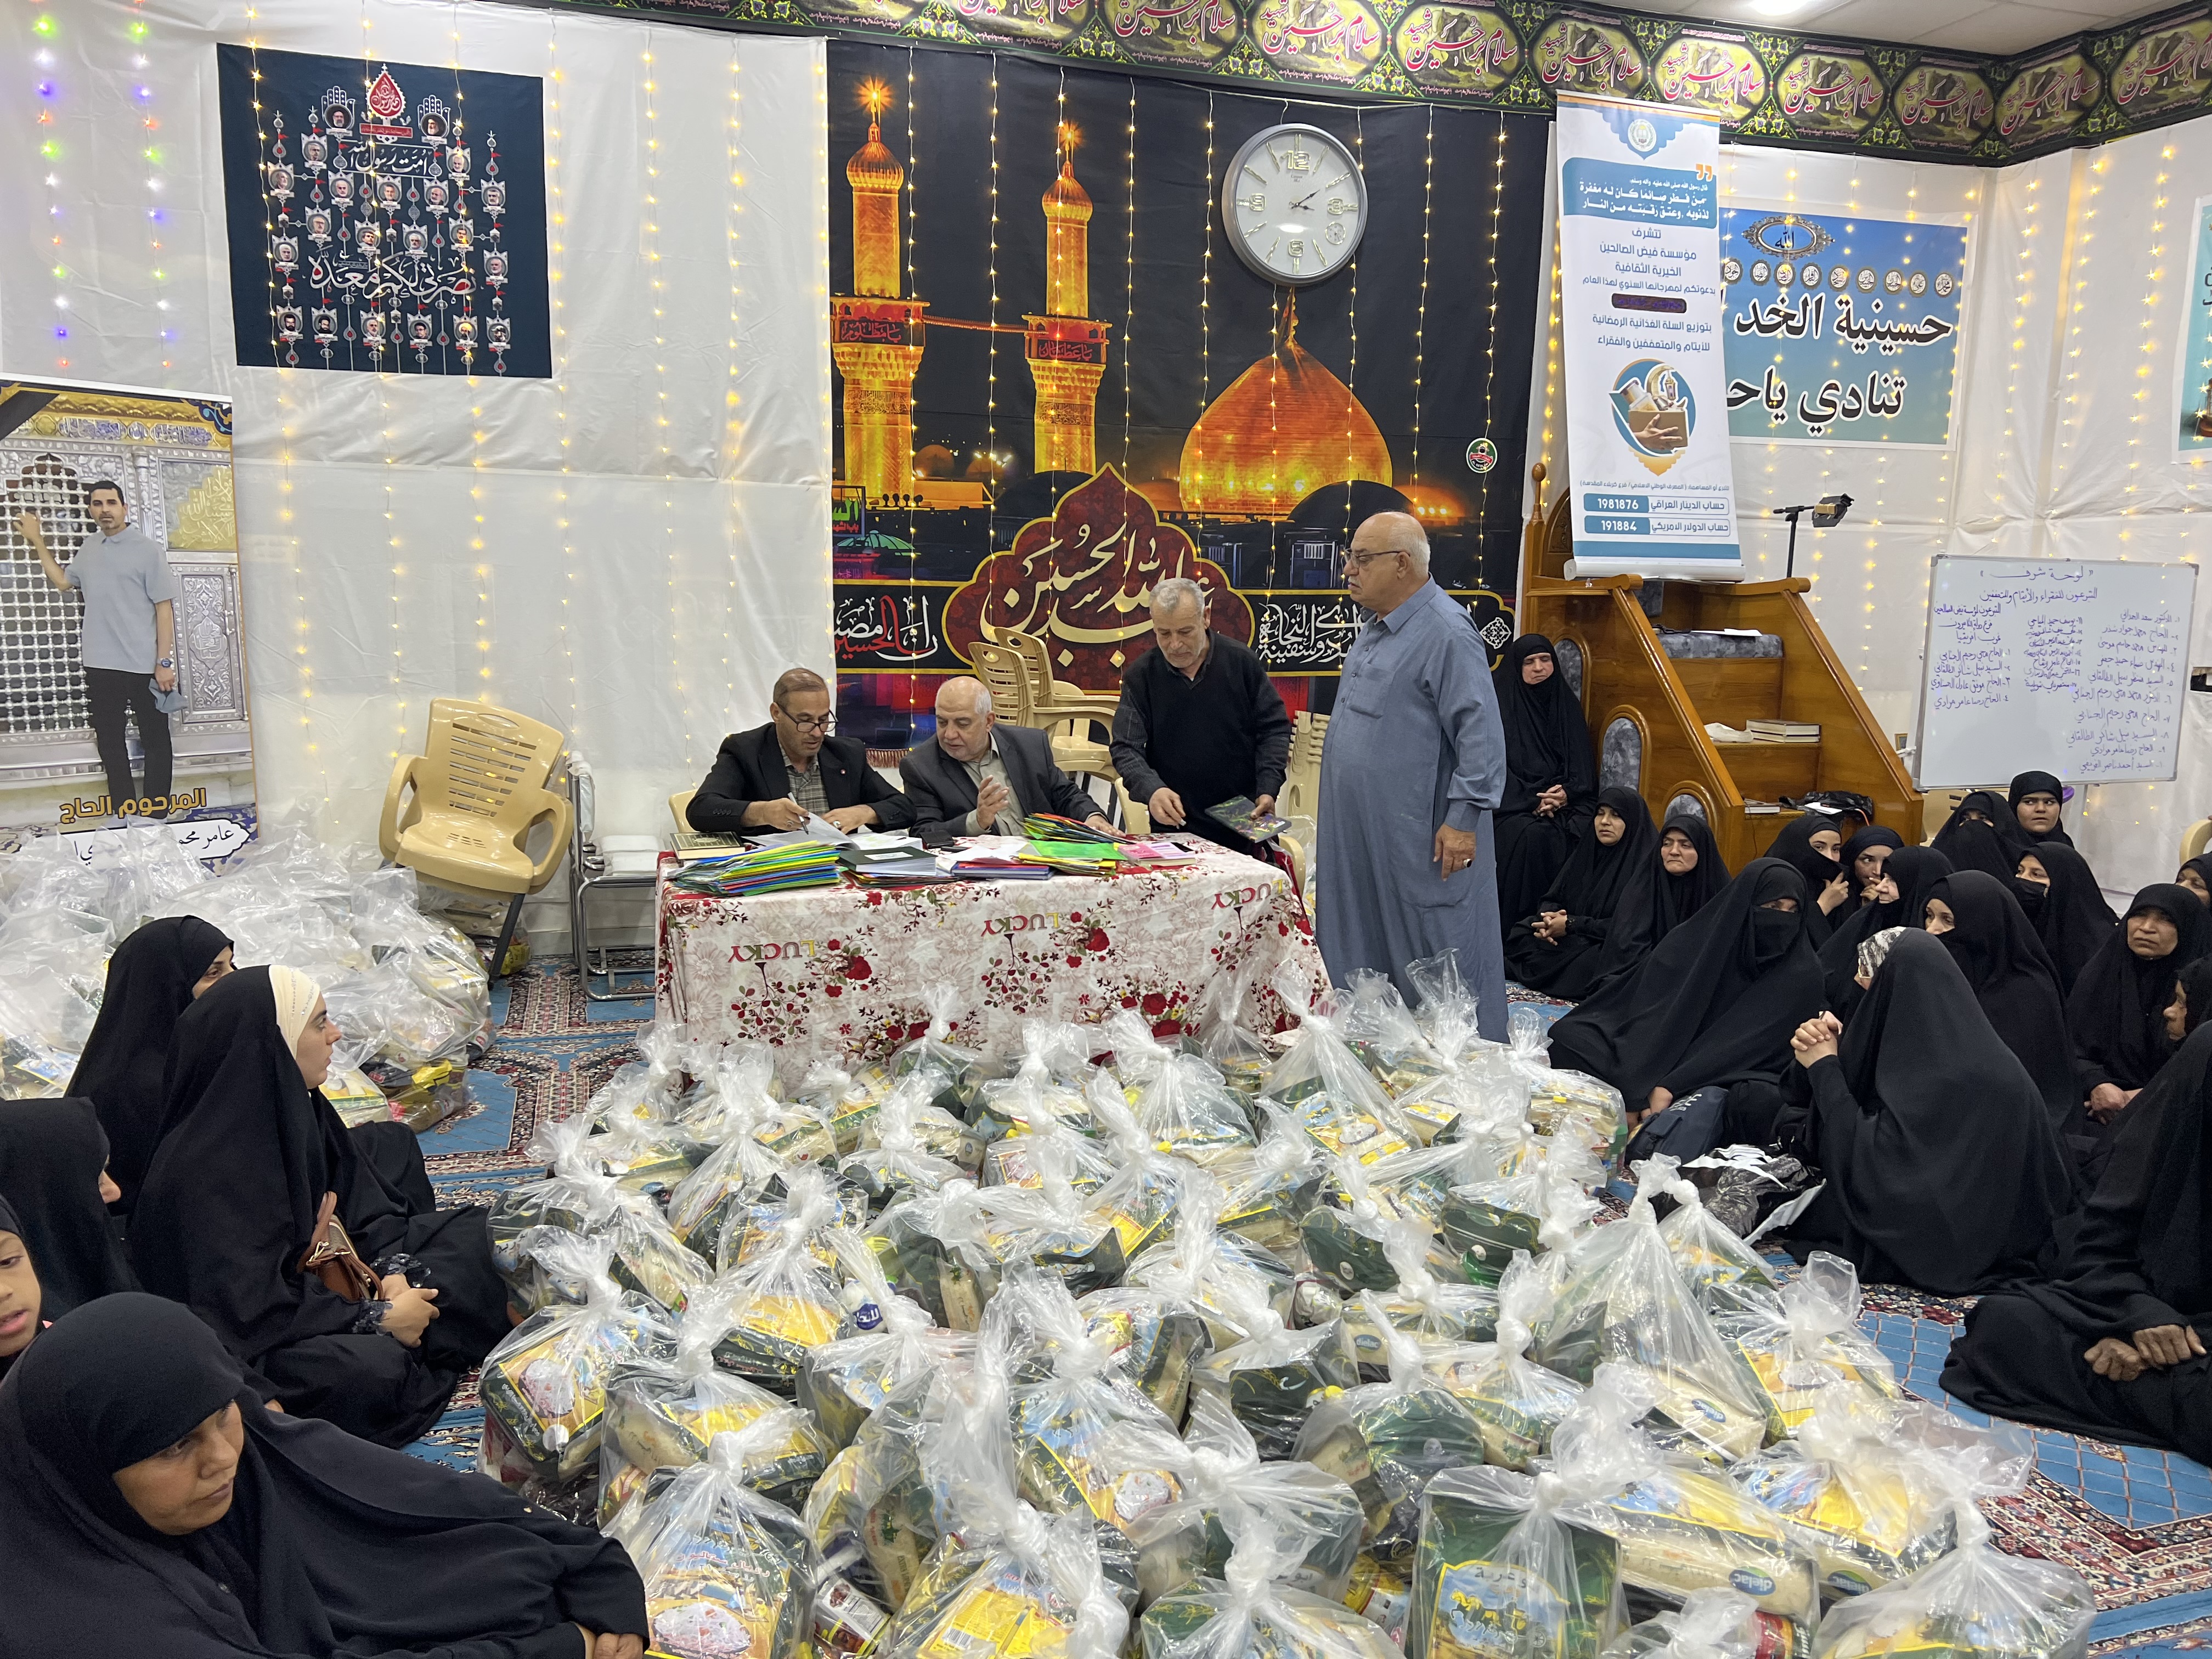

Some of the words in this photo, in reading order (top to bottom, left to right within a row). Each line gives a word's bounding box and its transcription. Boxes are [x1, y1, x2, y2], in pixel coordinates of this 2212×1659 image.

[1345, 14, 1381, 59] سلام
[1485, 28, 1517, 72] سلام
[1611, 46, 1641, 88] سلام
[1734, 61, 1764, 104] سلام
[2064, 66, 2099, 111] سلام
[1853, 75, 1883, 116] سلام
[1967, 88, 1994, 128] سلام
[1281, 150, 1311, 170] 12
[1249, 194, 1266, 211] 9
[1328, 197, 1344, 215] 3
[1583, 198, 1609, 209] النار
[1632, 227, 1661, 239] تتشرف
[1775, 225, 1794, 249] الله
[1289, 239, 1304, 257] 6
[1600, 241, 1634, 254] الصالحين
[1637, 246, 1658, 258] فيض
[1660, 248, 1696, 261] مؤسسة
[1615, 262, 1650, 274] الثقافية
[1652, 265, 1681, 278] الخيرية
[1583, 275, 1601, 285] العام
[1602, 278, 1617, 286] لهذا
[1619, 280, 1644, 290] السنوي
[1645, 281, 1682, 292] لمهرجانها
[1684, 284, 1716, 297] بدعوتكم
[1593, 314, 1628, 328] الرمضانية
[1629, 318, 1661, 329] الغذائية
[1662, 320, 1684, 330] السلة
[1836, 298, 1952, 354] حسينية
[1686, 323, 1712, 334] بتوزيع
[1598, 335, 1630, 348] والفقراء
[1633, 338, 1681, 352] والمتعففين
[1683, 342, 1710, 353] للأيتام
[1799, 371, 1906, 435] تنادي
[1598, 498, 1639, 510] 1981876
[1651, 500, 1678, 512] العراقي
[1680, 501, 1701, 511] الدينار
[1702, 503, 1724, 511] حساب
[1601, 521, 1637, 531] 191884
[1684, 523, 1706, 532] الدولار
[1707, 523, 1728, 532] حساب
[1989, 567, 2046, 580] شرف
[2049, 565, 2083, 582] لوحة
[2041, 589, 2064, 603] للفقراء
[1983, 619, 1993, 633] فرع
[2150, 626, 2168, 642] الحاج
[1989, 647, 2002, 662] الحاج
[1985, 661, 2002, 674] السيد
[1987, 675, 2001, 693] الحاج
[1934, 696, 1955, 709] مرادي
[1955, 696, 1971, 708] عامر
[1984, 693, 2001, 708] الحاج
[2142, 707, 2159, 727] الحاج
[2138, 743, 2153, 755] الحاج
[59, 795, 112, 823] الحاج
[119, 788, 206, 819] المرحوم
[202, 825, 234, 849] عامر
[1211, 879, 1283, 910] LUCKY
[981, 913, 1060, 937] LUCKY
[728, 940, 817, 962] LUCKY
[1357, 1338, 1379, 1348] dielac
[1695, 1400, 1724, 1421] dielac
[1734, 1573, 1773, 1592] dielac
